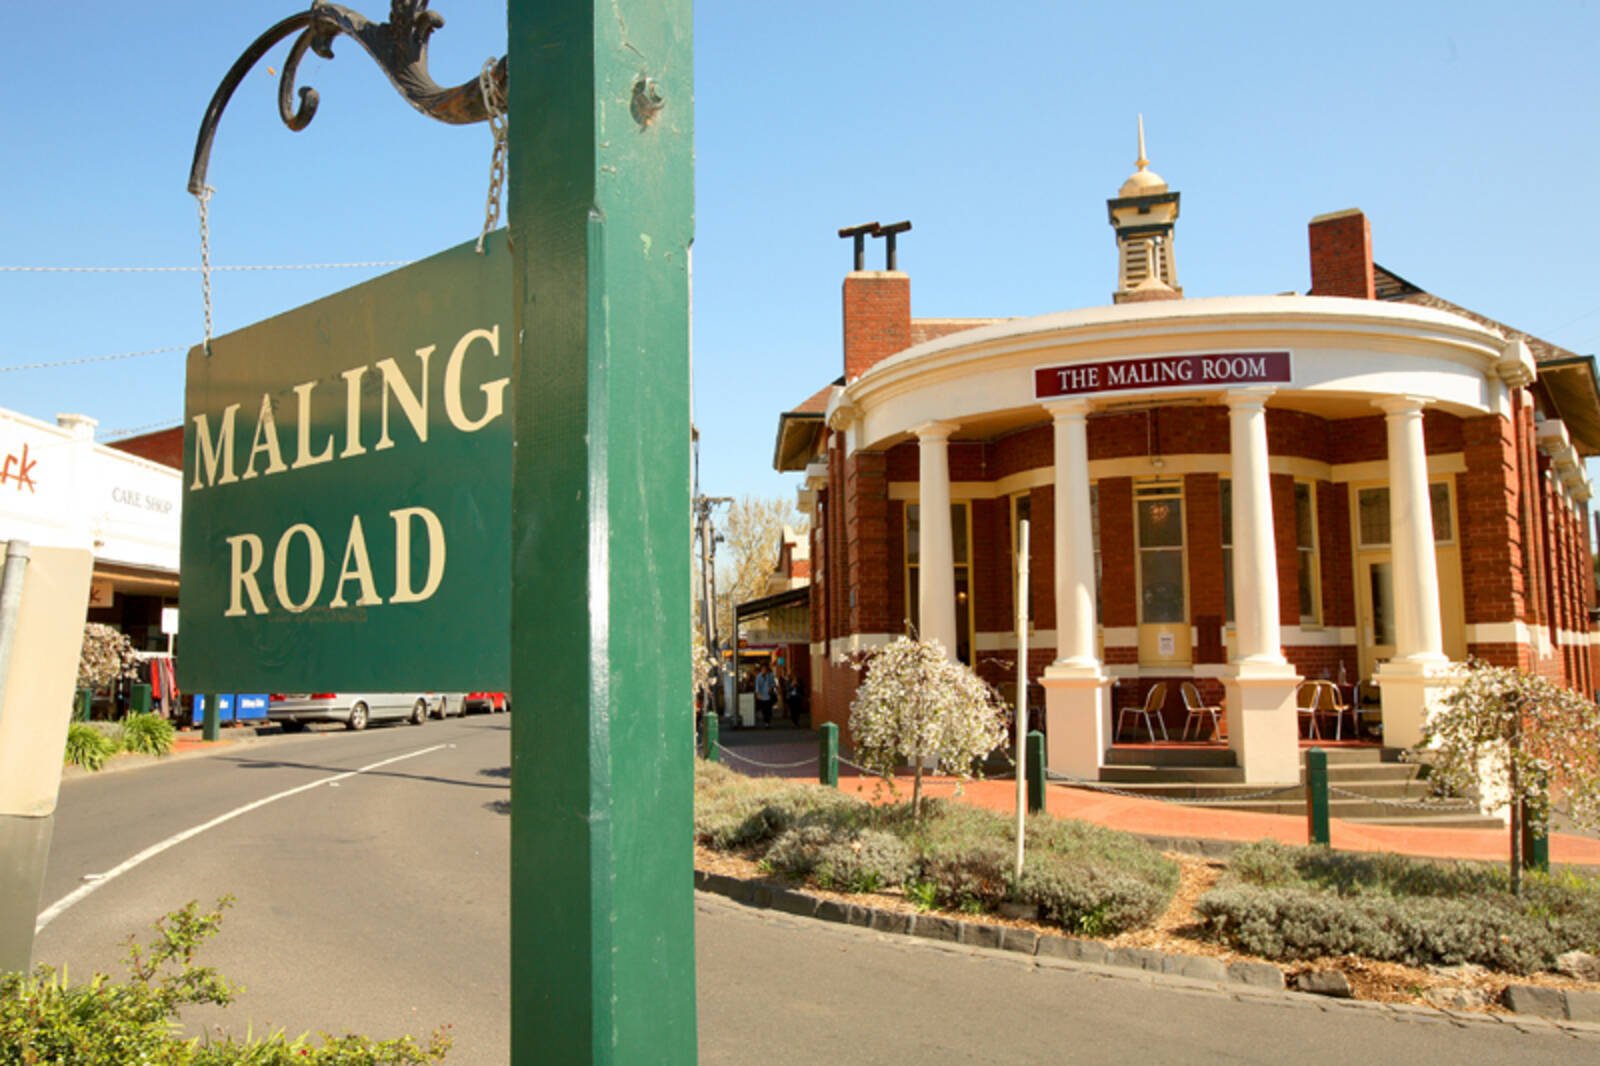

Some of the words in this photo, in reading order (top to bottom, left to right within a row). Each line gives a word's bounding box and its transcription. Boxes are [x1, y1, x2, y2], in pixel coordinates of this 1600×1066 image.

[190, 324, 510, 491] MALING
[1057, 367, 1100, 391] THE
[1107, 360, 1193, 386] MALING
[1202, 357, 1267, 380] ROOM
[111, 486, 142, 508] CAKE
[144, 495, 173, 514] SHOP
[224, 506, 447, 616] ROAD
